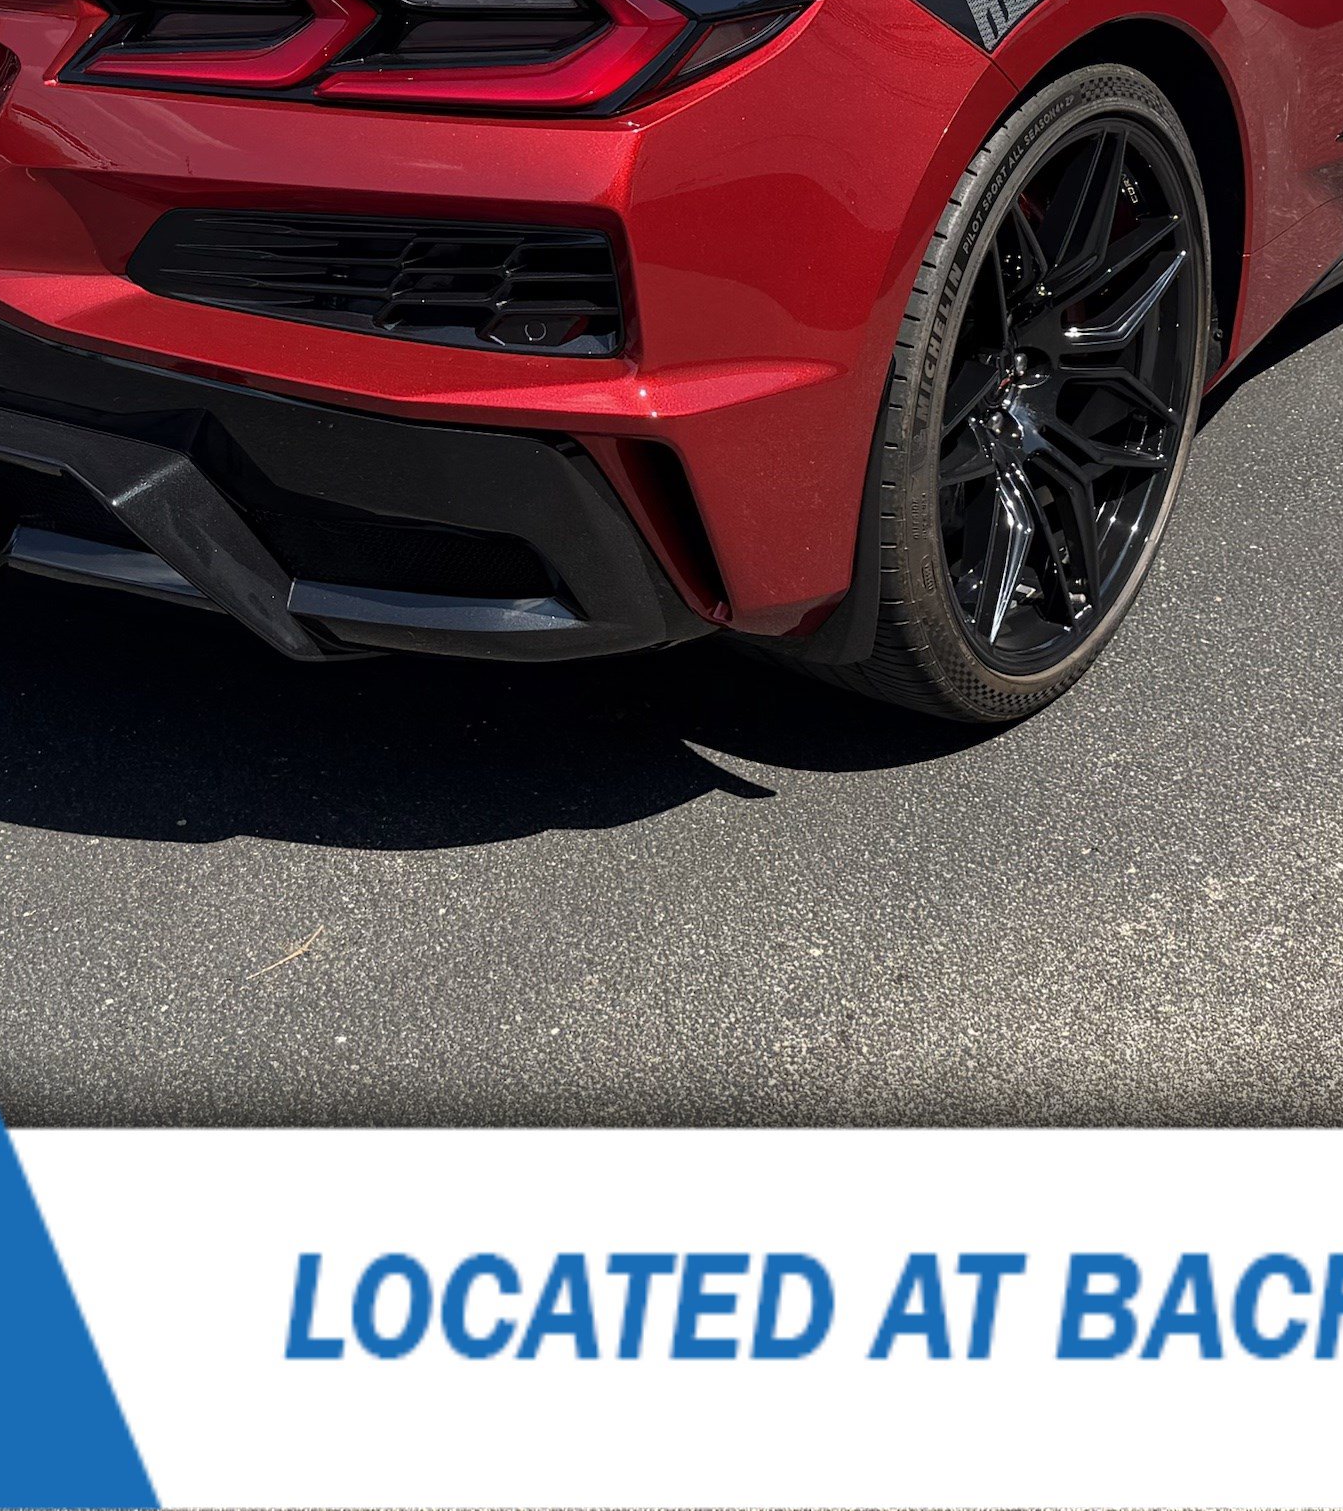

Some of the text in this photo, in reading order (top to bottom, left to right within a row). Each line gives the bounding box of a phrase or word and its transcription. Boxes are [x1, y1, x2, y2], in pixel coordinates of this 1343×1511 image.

[915, 262, 964, 428] MICHELIN
[962, 210, 984, 256] PILOT
[982, 166, 1008, 212] SPORT
[1007, 144, 1025, 170] ALL
[1024, 106, 1056, 147] SEASON
